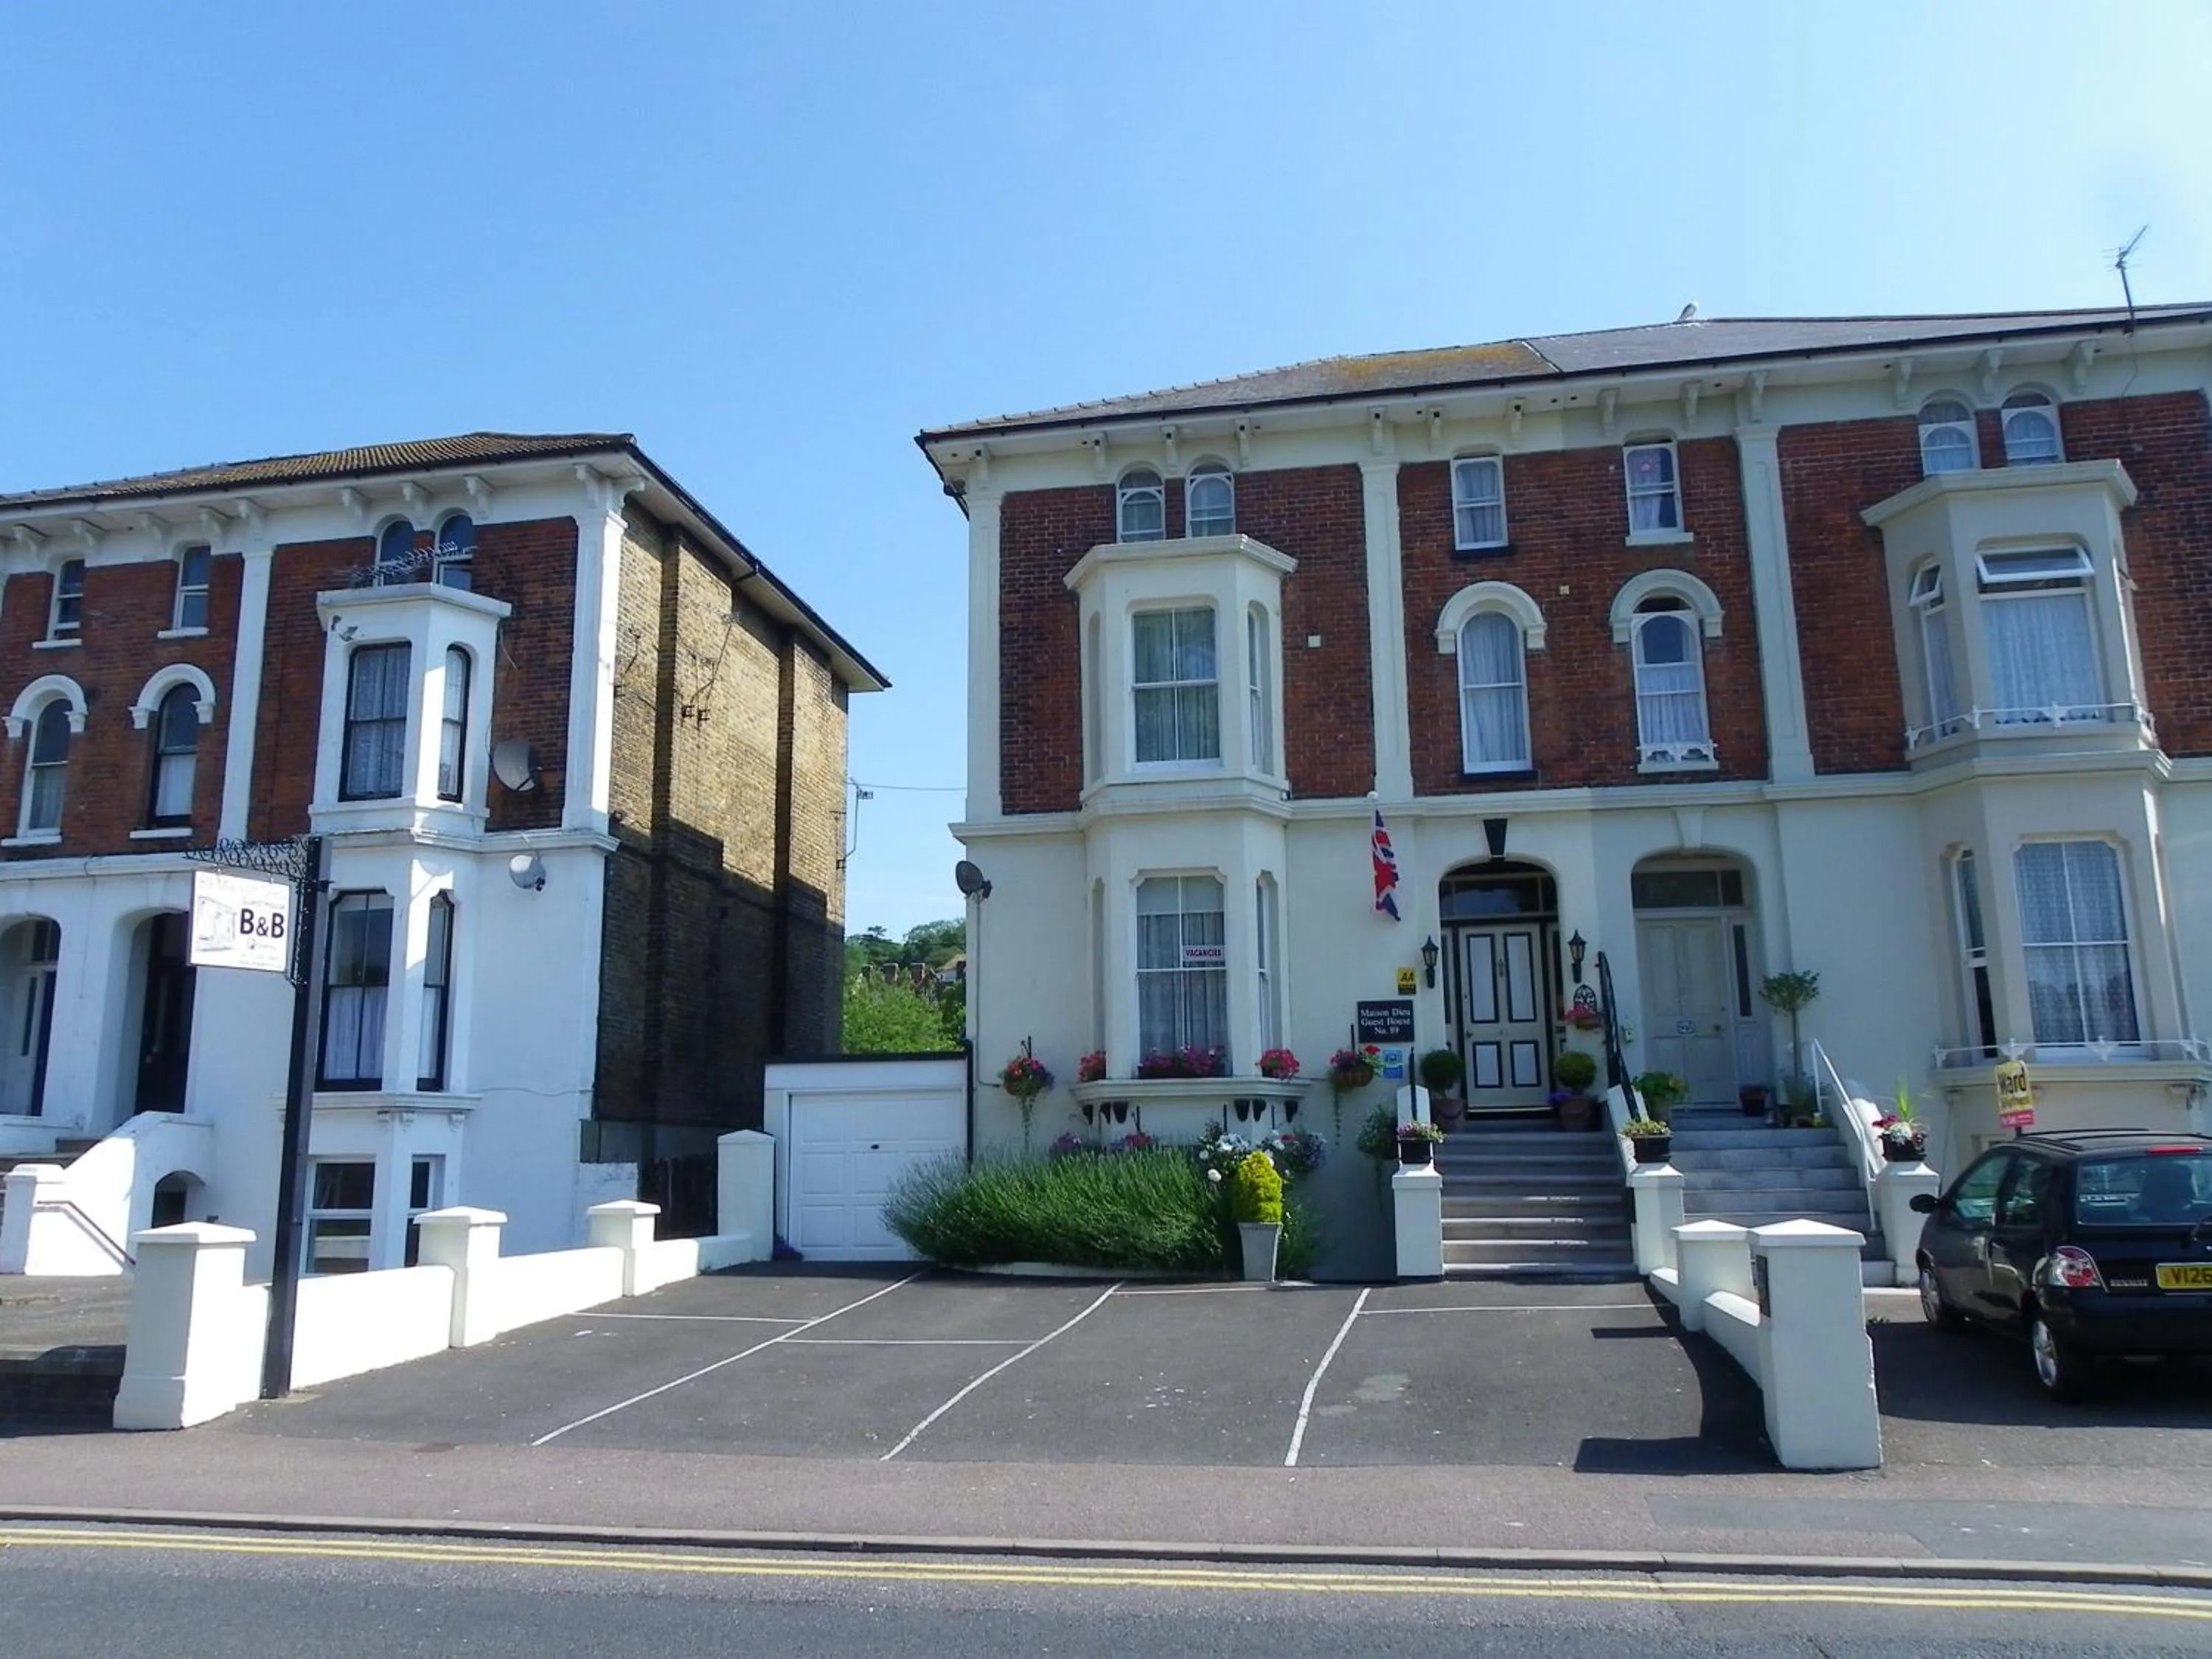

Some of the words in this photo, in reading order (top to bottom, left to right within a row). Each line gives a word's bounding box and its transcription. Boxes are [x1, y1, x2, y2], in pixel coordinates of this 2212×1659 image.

[240, 908, 285, 939] B&B
[1185, 948, 1222, 957] VACANCIES
[1400, 971, 1414, 982] AA
[1360, 1008, 1389, 1017] Maison
[1391, 1007, 1411, 1016] Dieu
[1360, 1018, 1384, 1026] Guest
[1387, 1018, 1411, 1026] House
[1997, 1065, 2027, 1096] Ward
